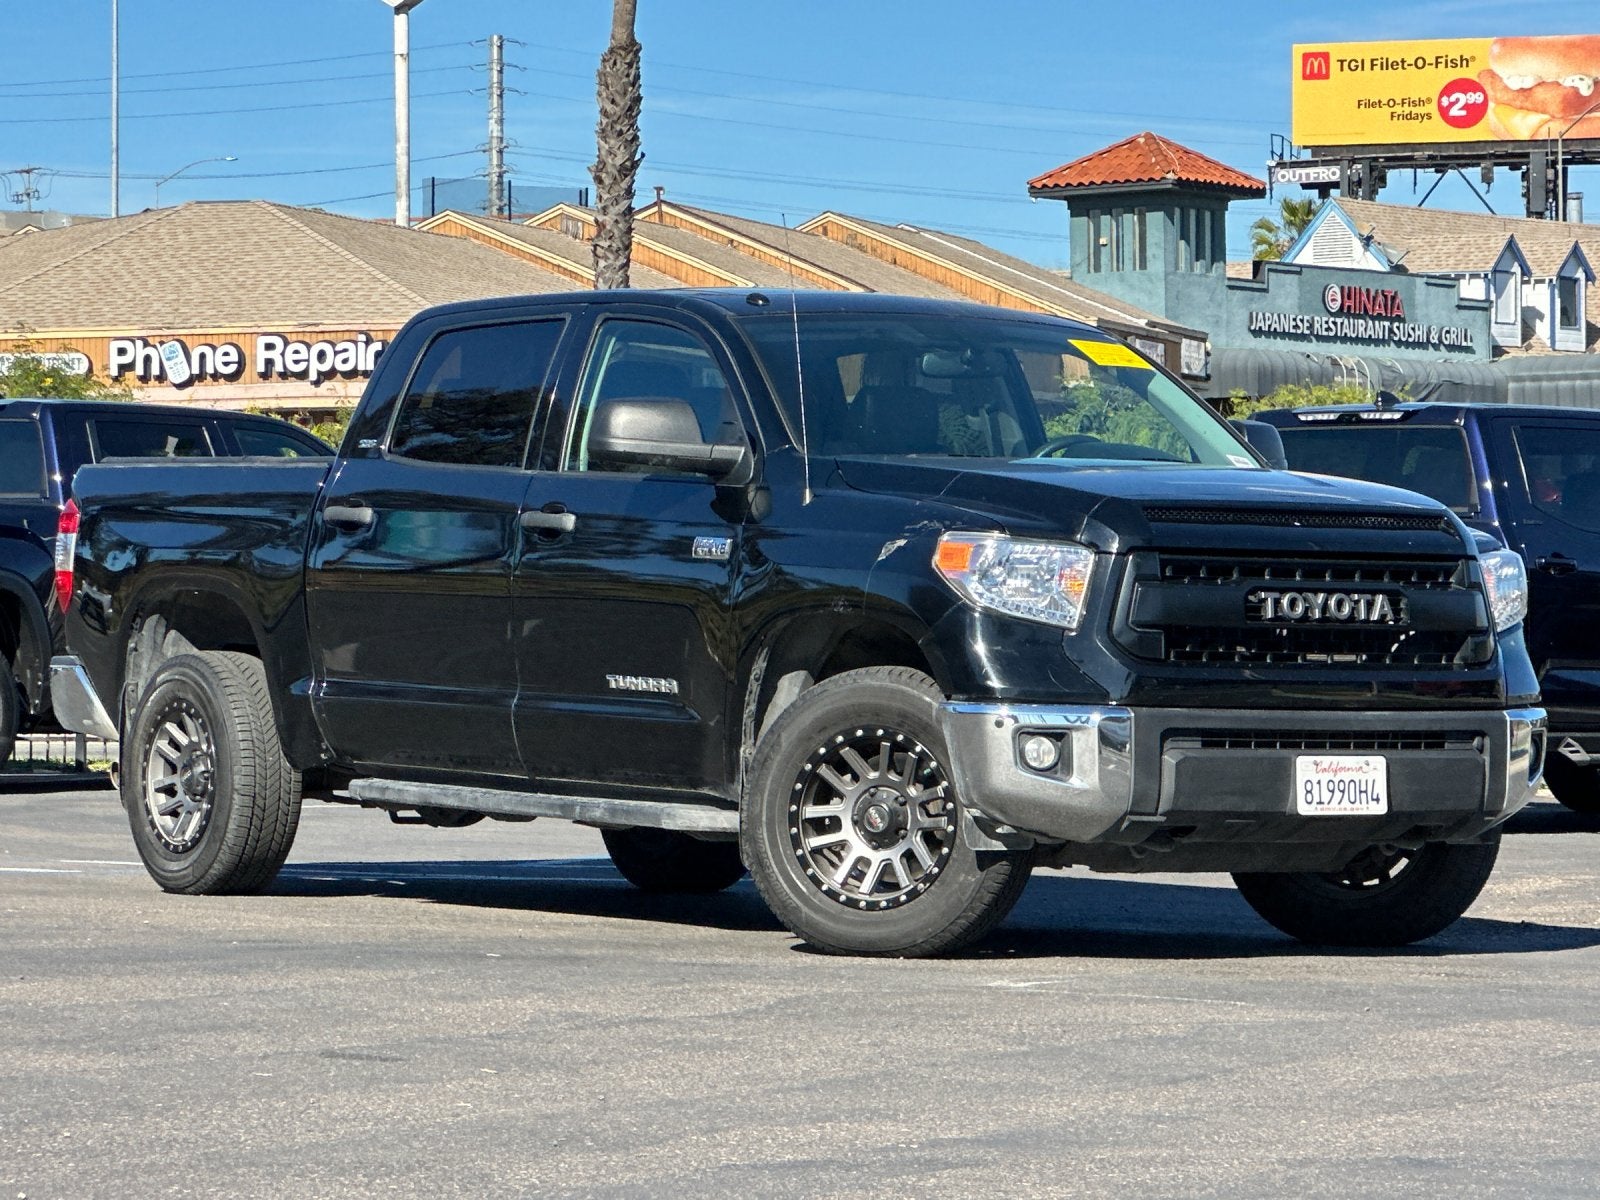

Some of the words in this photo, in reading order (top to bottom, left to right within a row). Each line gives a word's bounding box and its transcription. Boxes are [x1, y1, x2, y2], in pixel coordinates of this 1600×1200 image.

[1337, 58, 1365, 72] TGI
[1390, 110, 1433, 123] Fridays
[1342, 286, 1405, 317] HINATA
[1250, 311, 1310, 334] JAPANESE
[1314, 316, 1390, 340] RESTAURANT
[1393, 322, 1427, 343] SUSHI
[1430, 325, 1439, 344] &
[1441, 326, 1474, 346] GRILL
[256, 334, 382, 385] Repair
[1259, 591, 1395, 621] TOYOTA
[605, 674, 679, 694] TUNDRA
[1314, 761, 1370, 777] California
[1304, 779, 1380, 805] 81990H4
